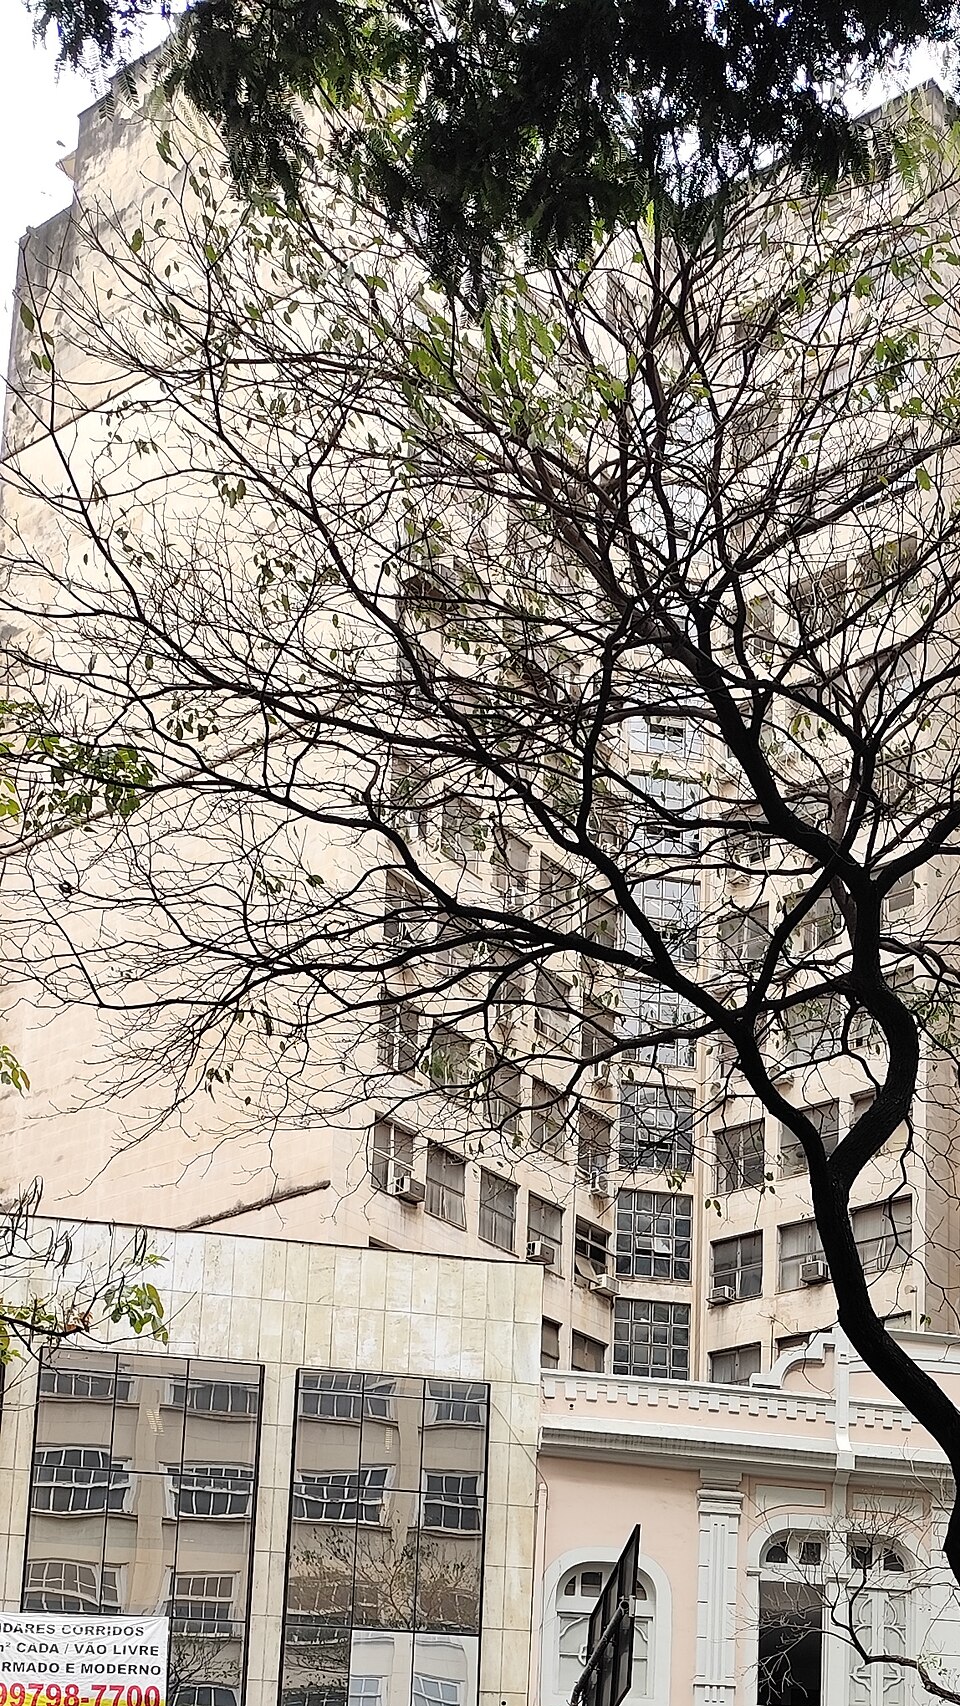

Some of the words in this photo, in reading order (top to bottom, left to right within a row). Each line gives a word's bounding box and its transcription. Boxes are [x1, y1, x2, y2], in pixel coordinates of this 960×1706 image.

[0, 1623, 56, 1635] DARES
[61, 1625, 145, 1637] CORRIDOS
[16, 1642, 59, 1654] CADA
[74, 1642, 107, 1655] VÃO
[113, 1645, 159, 1657] LIVRE
[65, 1663, 75, 1674] E
[80, 1663, 162, 1676] MODERNO
